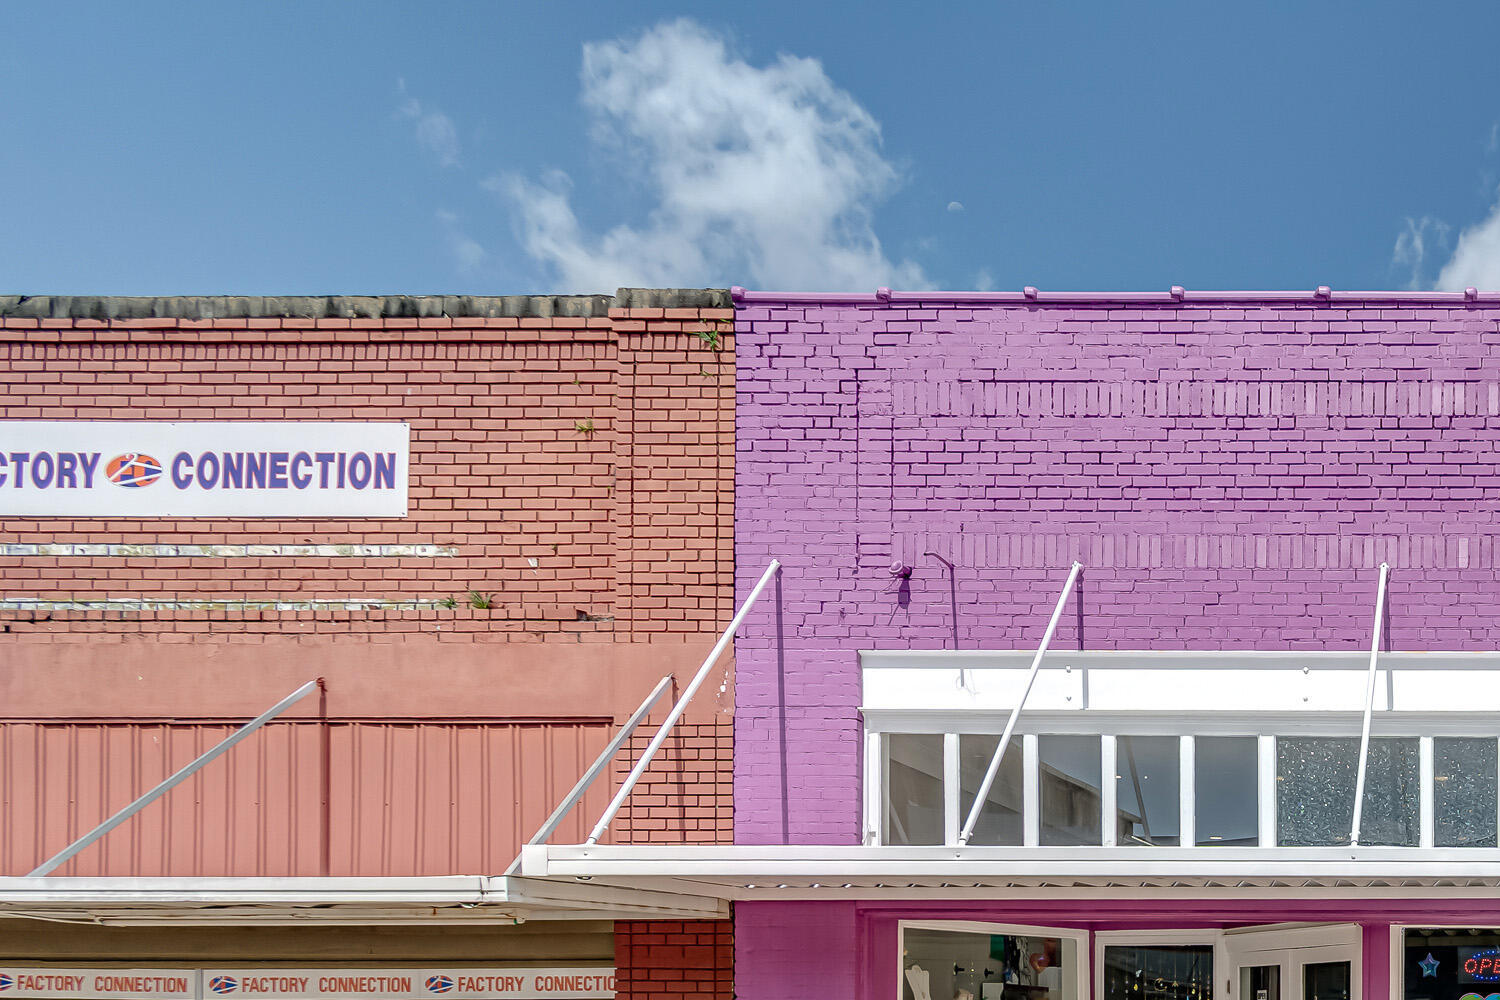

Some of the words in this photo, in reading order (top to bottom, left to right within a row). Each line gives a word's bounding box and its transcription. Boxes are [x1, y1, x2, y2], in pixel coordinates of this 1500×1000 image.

[172, 451, 396, 490] CONNECTION
[17, 975, 85, 991] FACTORY
[94, 976, 188, 993] CONNECTION
[242, 977, 310, 993] FACTORY
[319, 977, 411, 993] CONNECTION
[458, 976, 524, 992] FACTORY
